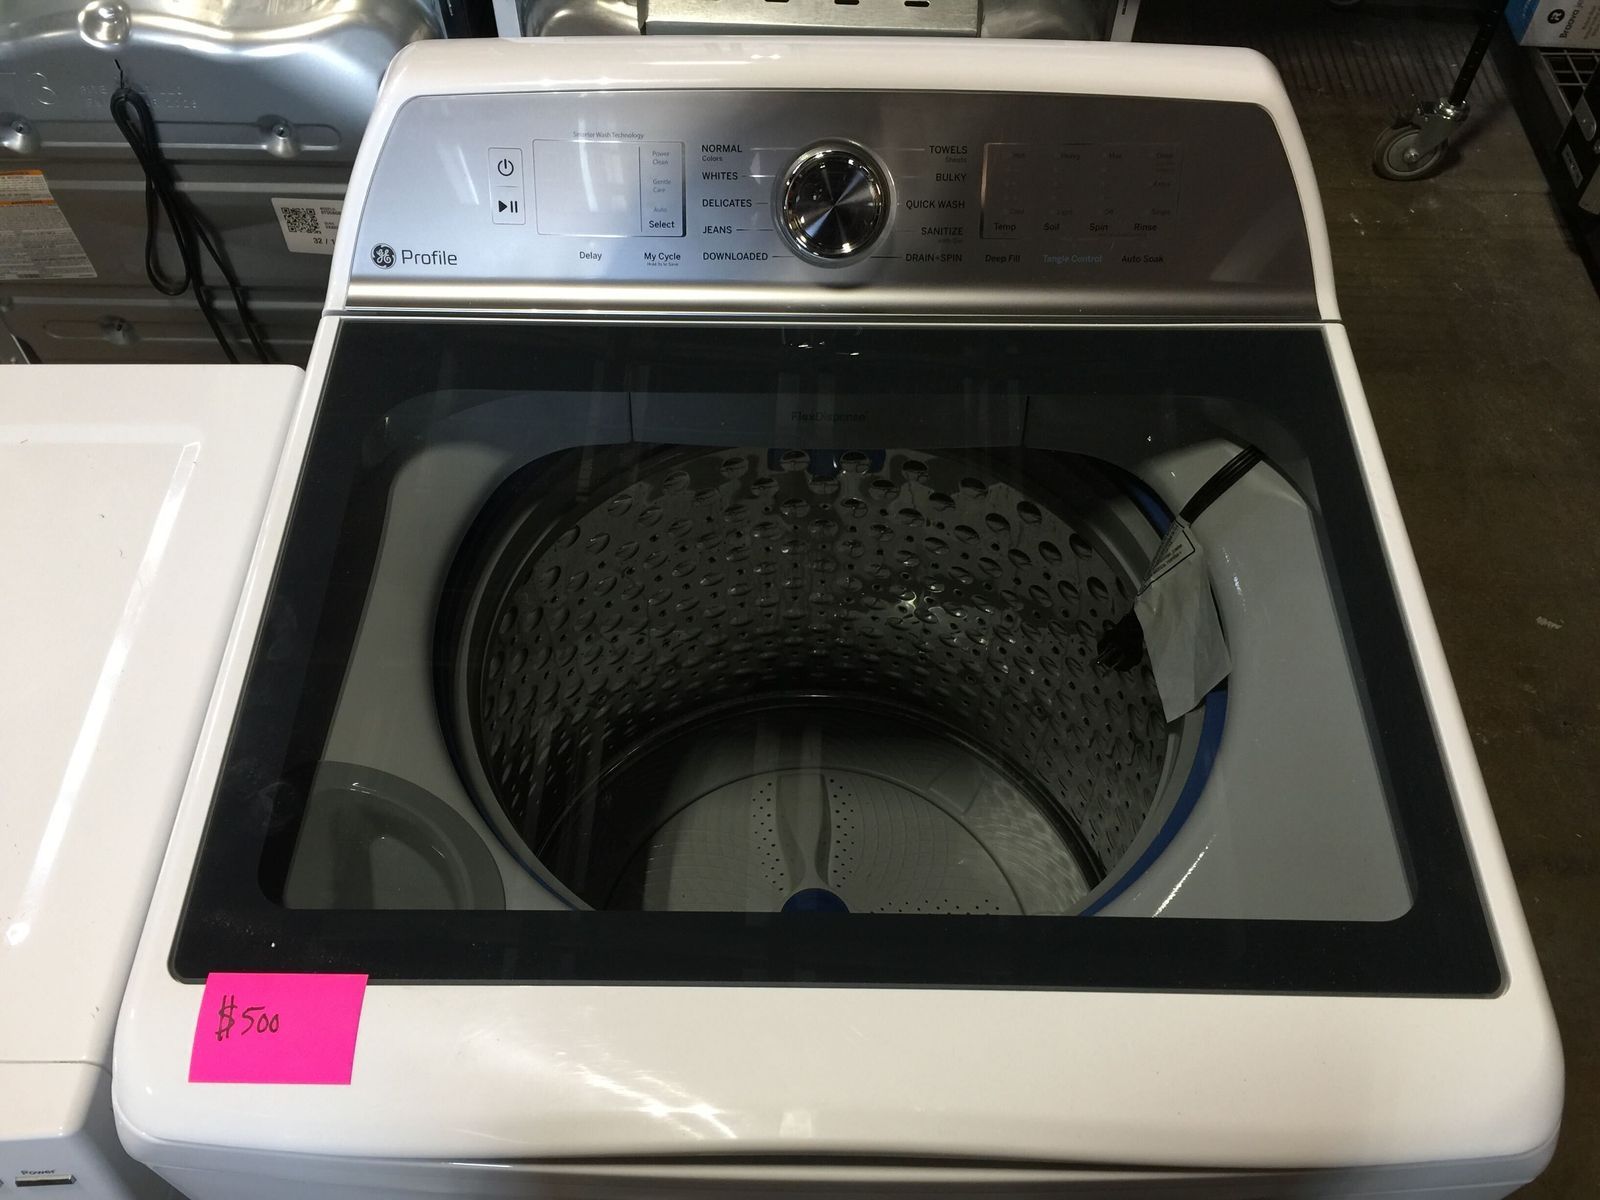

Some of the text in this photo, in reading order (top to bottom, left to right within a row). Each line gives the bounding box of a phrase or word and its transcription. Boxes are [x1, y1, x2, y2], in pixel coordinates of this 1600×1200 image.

[573, 131, 645, 140] Smarter Wash Technology
[701, 144, 743, 153] NORMAL
[929, 145, 968, 154] TOWELS
[701, 171, 739, 180] WHITES
[935, 172, 967, 182] BULKY
[702, 198, 753, 208] DELICATES
[905, 199, 966, 210] QUICK WASH
[648, 220, 675, 229] Select
[993, 223, 1017, 234] Temp
[1043, 222, 1060, 232] Soil
[1089, 223, 1109, 234] Spin
[1133, 223, 1158, 232] Rinse
[702, 225, 733, 235] JEANS
[920, 226, 964, 236] SANITIZE
[401, 249, 458, 266] Profile
[579, 250, 602, 261] Delay
[644, 251, 682, 262] My Cycle
[702, 251, 769, 261] DOWNLOADED
[984, 253, 1021, 264] Deep Fill
[1042, 253, 1103, 265] Tangle Control
[1121, 253, 1165, 264] Auto Soak
[214, 994, 280, 1042] $500
